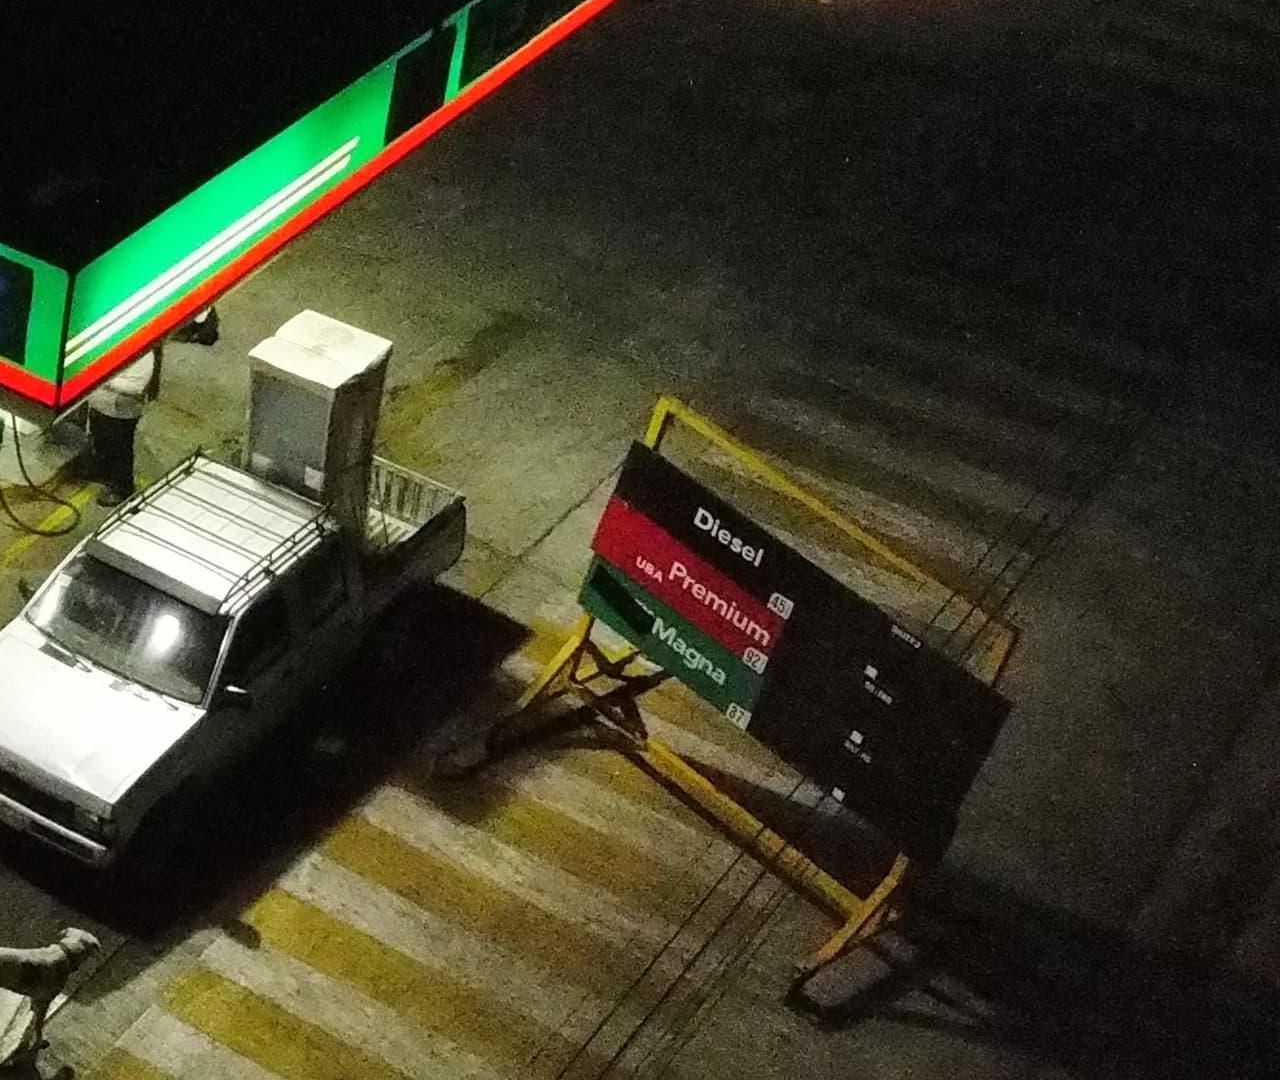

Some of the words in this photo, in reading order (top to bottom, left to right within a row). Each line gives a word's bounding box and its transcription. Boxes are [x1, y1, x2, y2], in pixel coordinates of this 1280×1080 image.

[693, 507, 765, 567] Diesel
[668, 561, 771, 647] Premium
[651, 617, 727, 686] Magna
